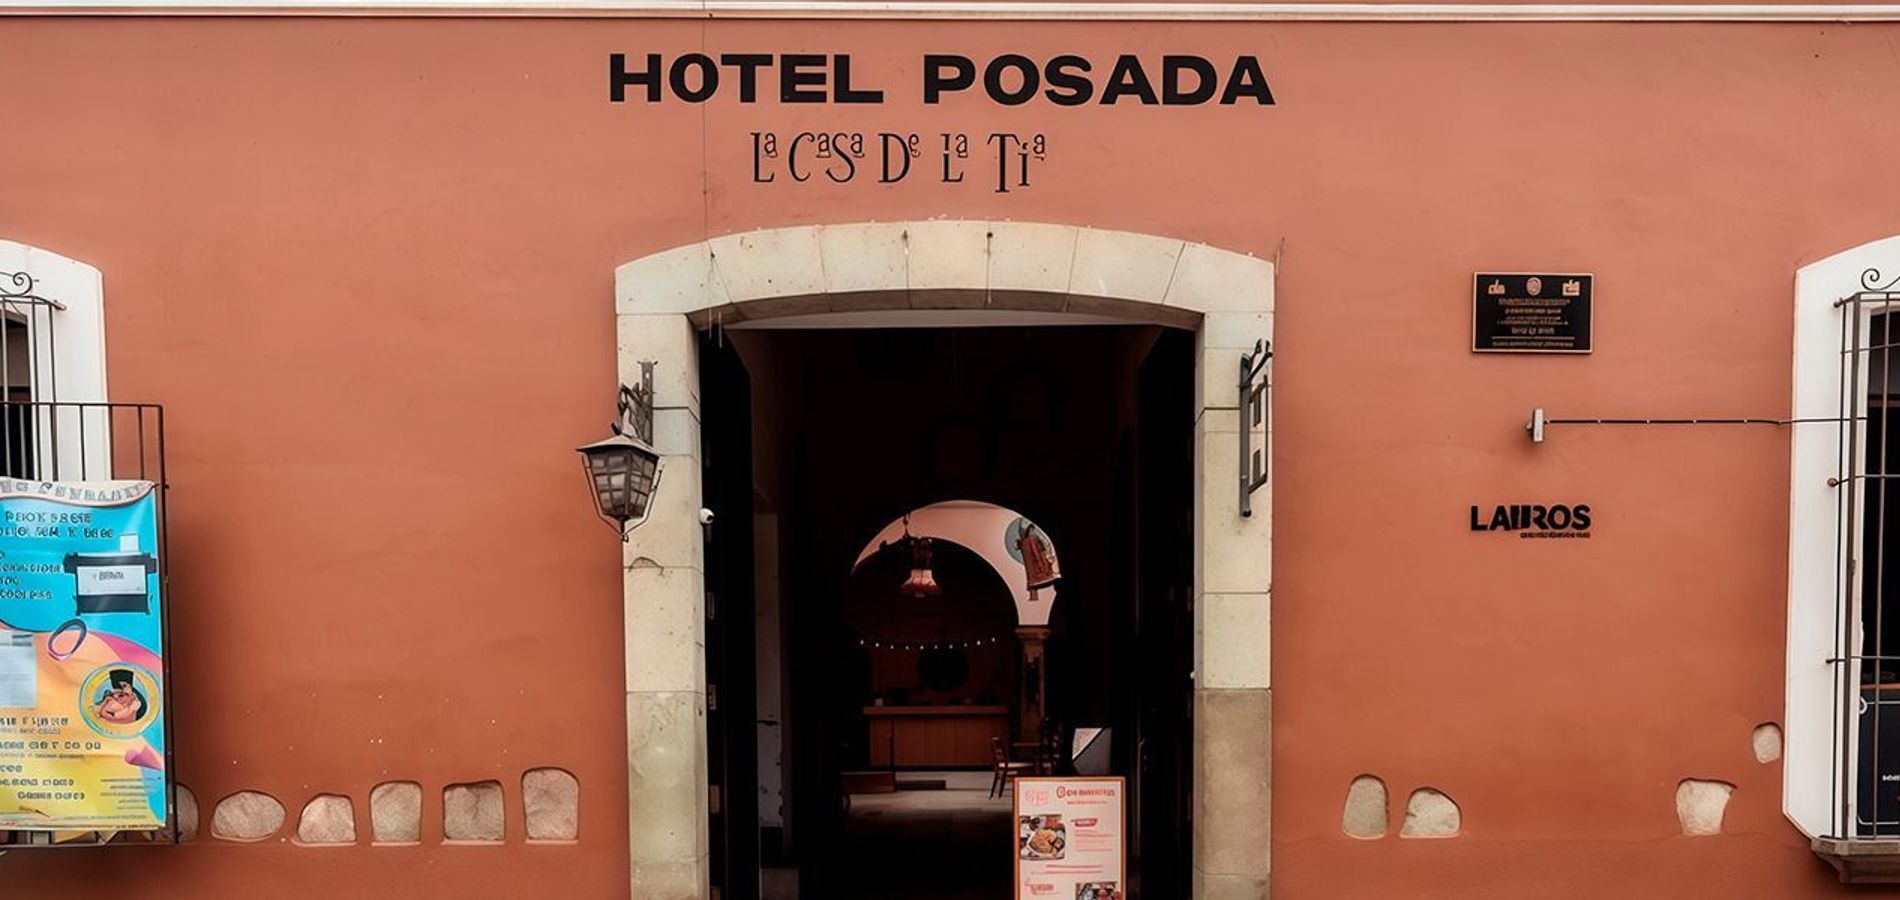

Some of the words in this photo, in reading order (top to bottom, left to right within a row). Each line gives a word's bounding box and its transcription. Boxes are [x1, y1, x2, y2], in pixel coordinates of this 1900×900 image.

[609, 53, 884, 104] HOTEL
[923, 53, 1276, 106] POSADA
[750, 132, 779, 183] La
[877, 132, 920, 183] De
